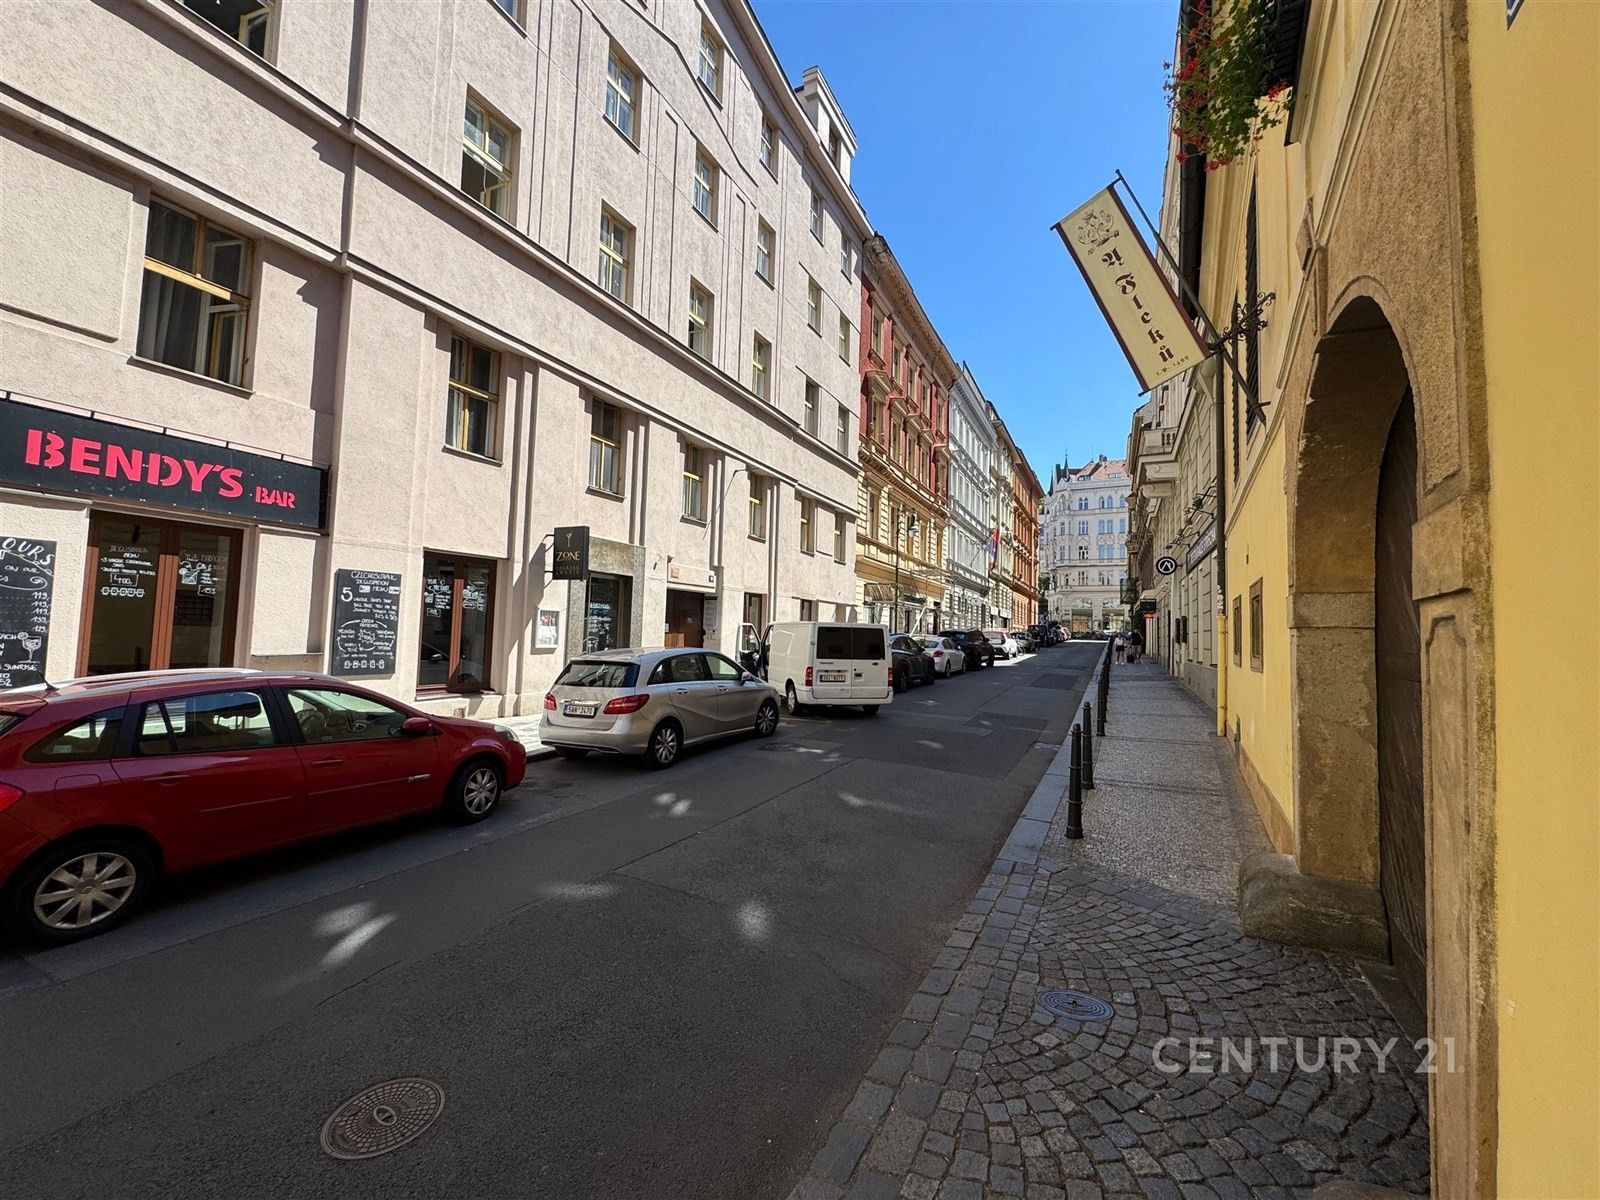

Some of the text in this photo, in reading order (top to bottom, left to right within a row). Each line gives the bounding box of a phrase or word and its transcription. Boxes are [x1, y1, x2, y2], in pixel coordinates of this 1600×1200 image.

[25, 428, 297, 509] BENDY'S BAR
[556, 550, 581, 562] ZONE
[340, 586, 353, 602] 5
